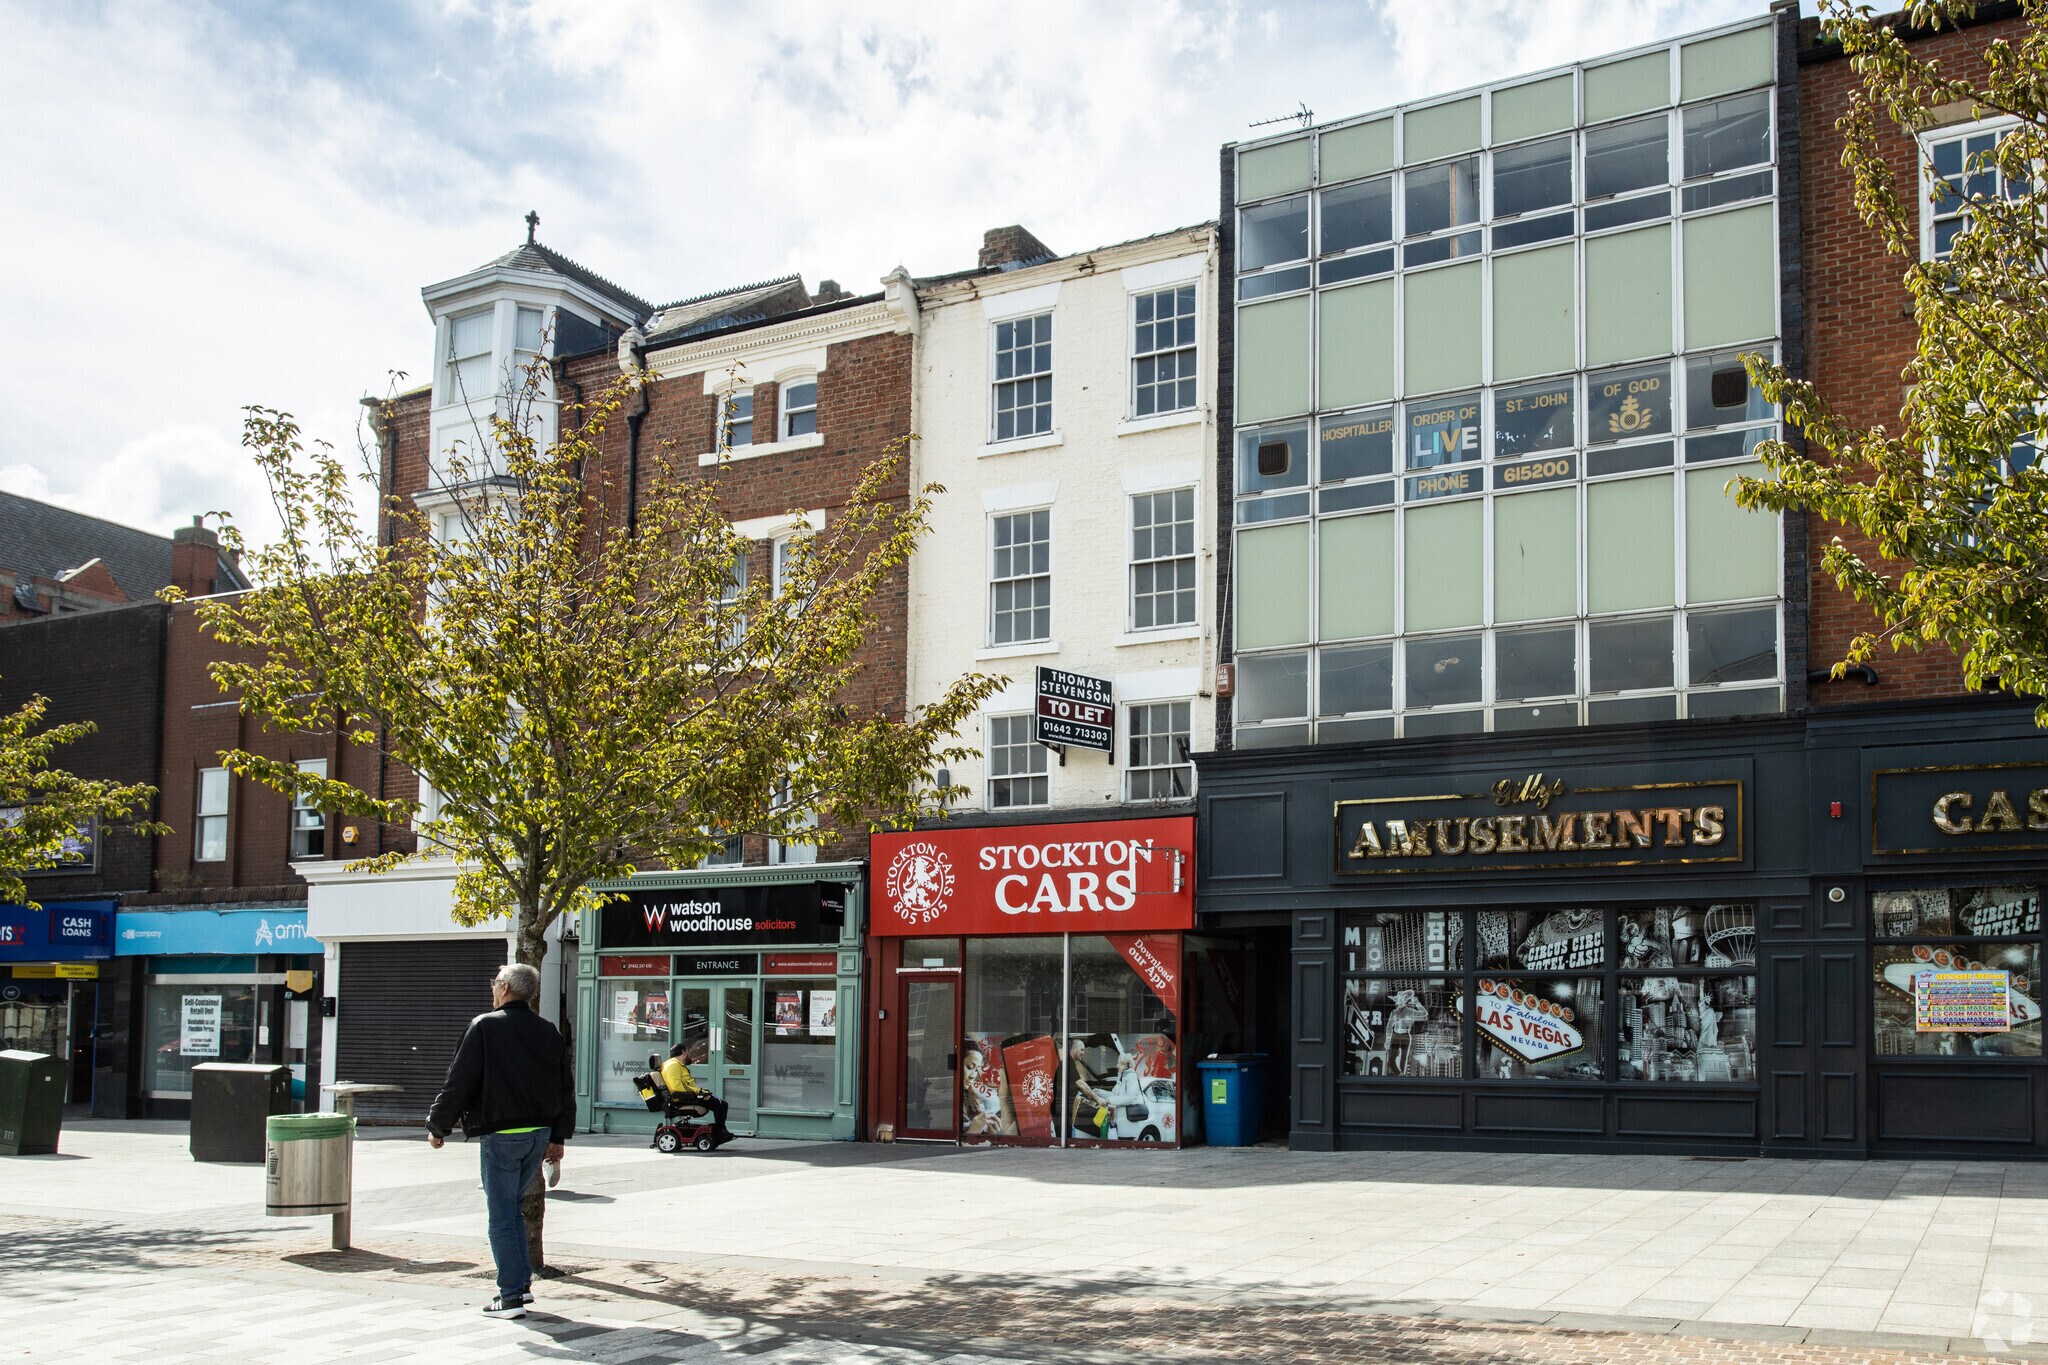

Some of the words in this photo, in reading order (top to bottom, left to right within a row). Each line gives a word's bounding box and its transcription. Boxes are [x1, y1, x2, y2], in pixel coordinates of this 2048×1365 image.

[1321, 420, 1393, 441] HOSPITALLER
[1412, 410, 1455, 427] ORDER
[1459, 406, 1477, 420] OF
[1505, 399, 1524, 413] ST.
[1530, 392, 1568, 409] JOHN
[1603, 383, 1622, 397] OF
[1628, 378, 1660, 393] GOD
[1414, 426, 1478, 457] LIVE
[1418, 473, 1470, 494] PHONE
[1503, 459, 1570, 483] 615200
[1041, 680, 1110, 704] STEVENSON
[1051, 671, 1101, 690] THOMAS
[1048, 699, 1071, 717] TO
[1074, 704, 1105, 723] LET
[1043, 721, 1071, 735] 01642
[1075, 727, 1108, 741] 713303
[1348, 804, 1726, 860] AMUSEMENTS
[979, 838, 1154, 871] STOCKTON
[886, 842, 937, 898] STOCKTON
[937, 852, 956, 897] CARS
[994, 869, 1136, 915] CARS
[670, 900, 721, 915] watson
[893, 901, 917, 925] 805
[922, 899, 948, 923] 805
[1973, 901, 2023, 926] CIRCUS
[0, 925, 13, 941] rs
[62, 928, 92, 937] LOANS
[63, 917, 92, 928] CASH
[670, 915, 753, 932] woodhouse
[754, 919, 797, 931] solicitors
[135, 931, 162, 939] company
[1134, 938, 1174, 982] Download
[1527, 938, 1568, 962] CIRCUS
[696, 960, 740, 970] ENTRANCE
[1128, 947, 1147, 967] our
[1145, 965, 1166, 990] App
[1973, 972, 2006, 980] SPECIALS
[184, 998, 220, 1006] Self-Contained
[189, 1007, 204, 1015] Retail
[1479, 979, 1574, 1021] WELCOME
[1476, 1006, 1514, 1031] LAS
[1519, 1018, 1573, 1048] VEGAS
[1489, 1000, 1502, 1010] TO
[1504, 1003, 1560, 1030] Fabulous
[1510, 1034, 1549, 1051] NEVADA
[789, 1070, 826, 1078] woodhouse
[973, 1081, 993, 1099] 805
